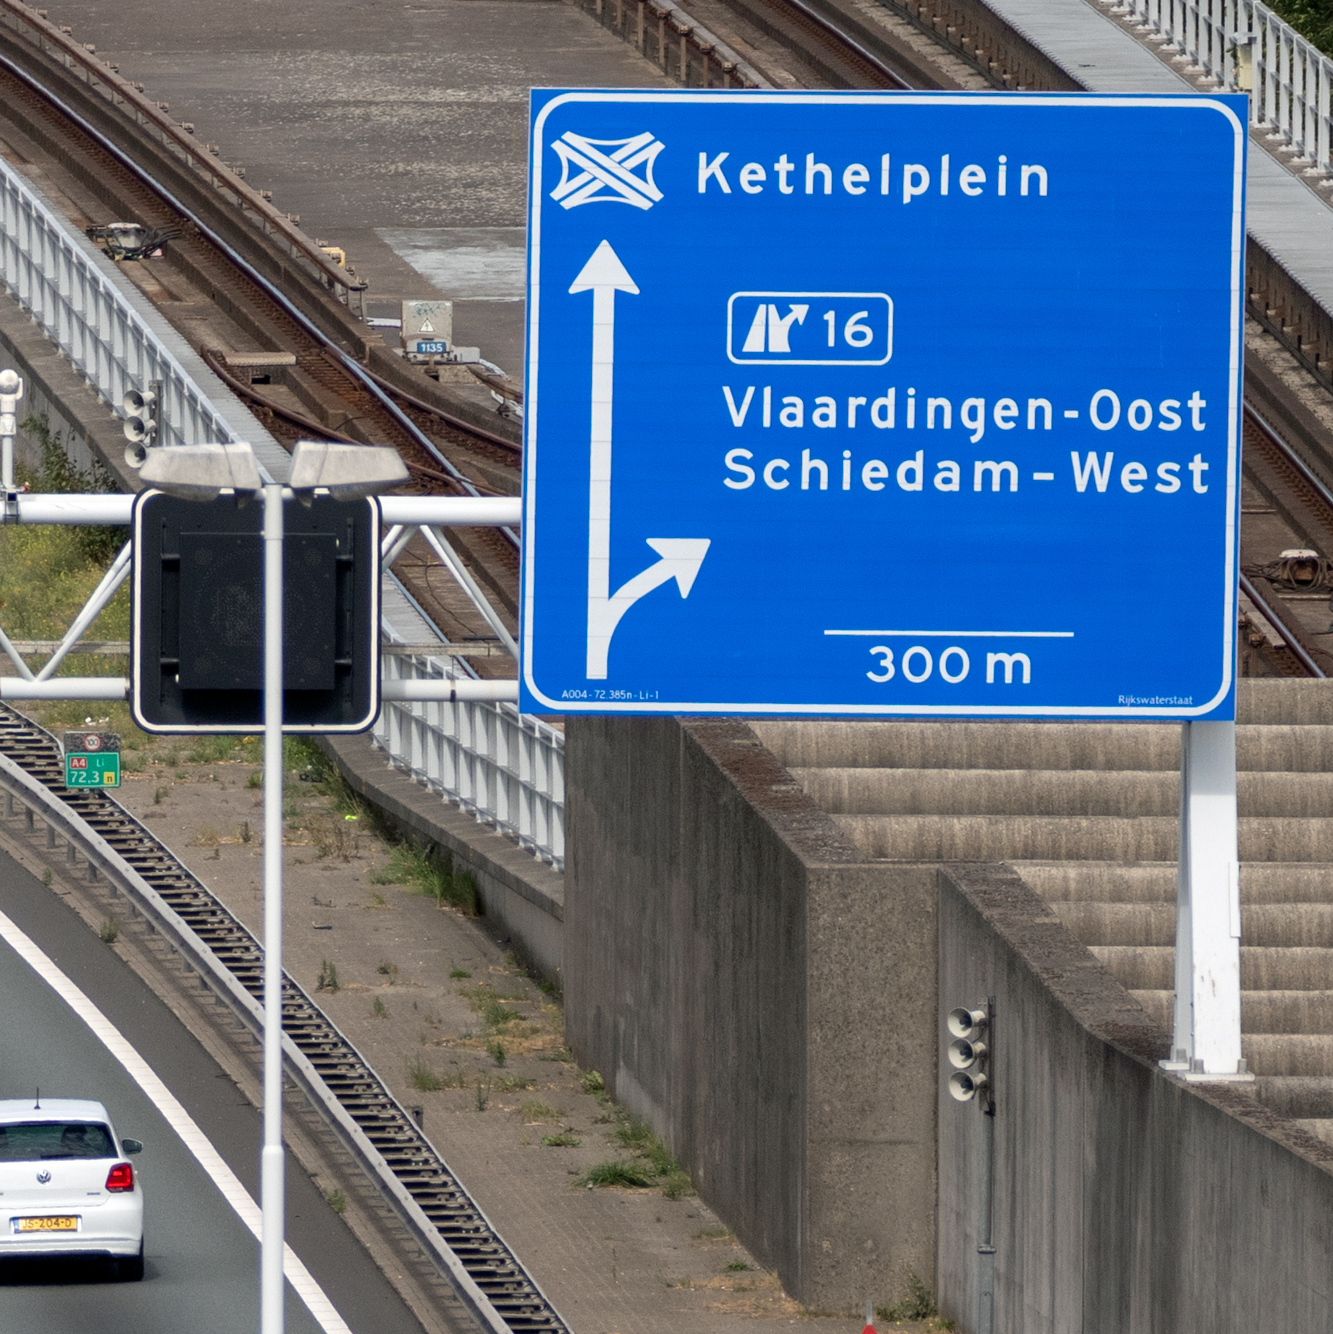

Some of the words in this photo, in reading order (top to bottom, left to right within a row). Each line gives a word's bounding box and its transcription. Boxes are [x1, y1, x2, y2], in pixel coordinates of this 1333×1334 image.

[697, 151, 1048, 204] Kethelplein
[421, 343, 443, 352] 1135
[823, 310, 874, 348] 16
[722, 385, 1207, 444] Vlaardingen-Oost
[723, 448, 1209, 494] Schiedam-West
[866, 645, 970, 684] 300
[985, 652, 1031, 684] m
[1118, 695, 1193, 707] Rijkswaterstaat
[70, 771, 100, 785] 72,3
[71, 759, 86, 768] A4
